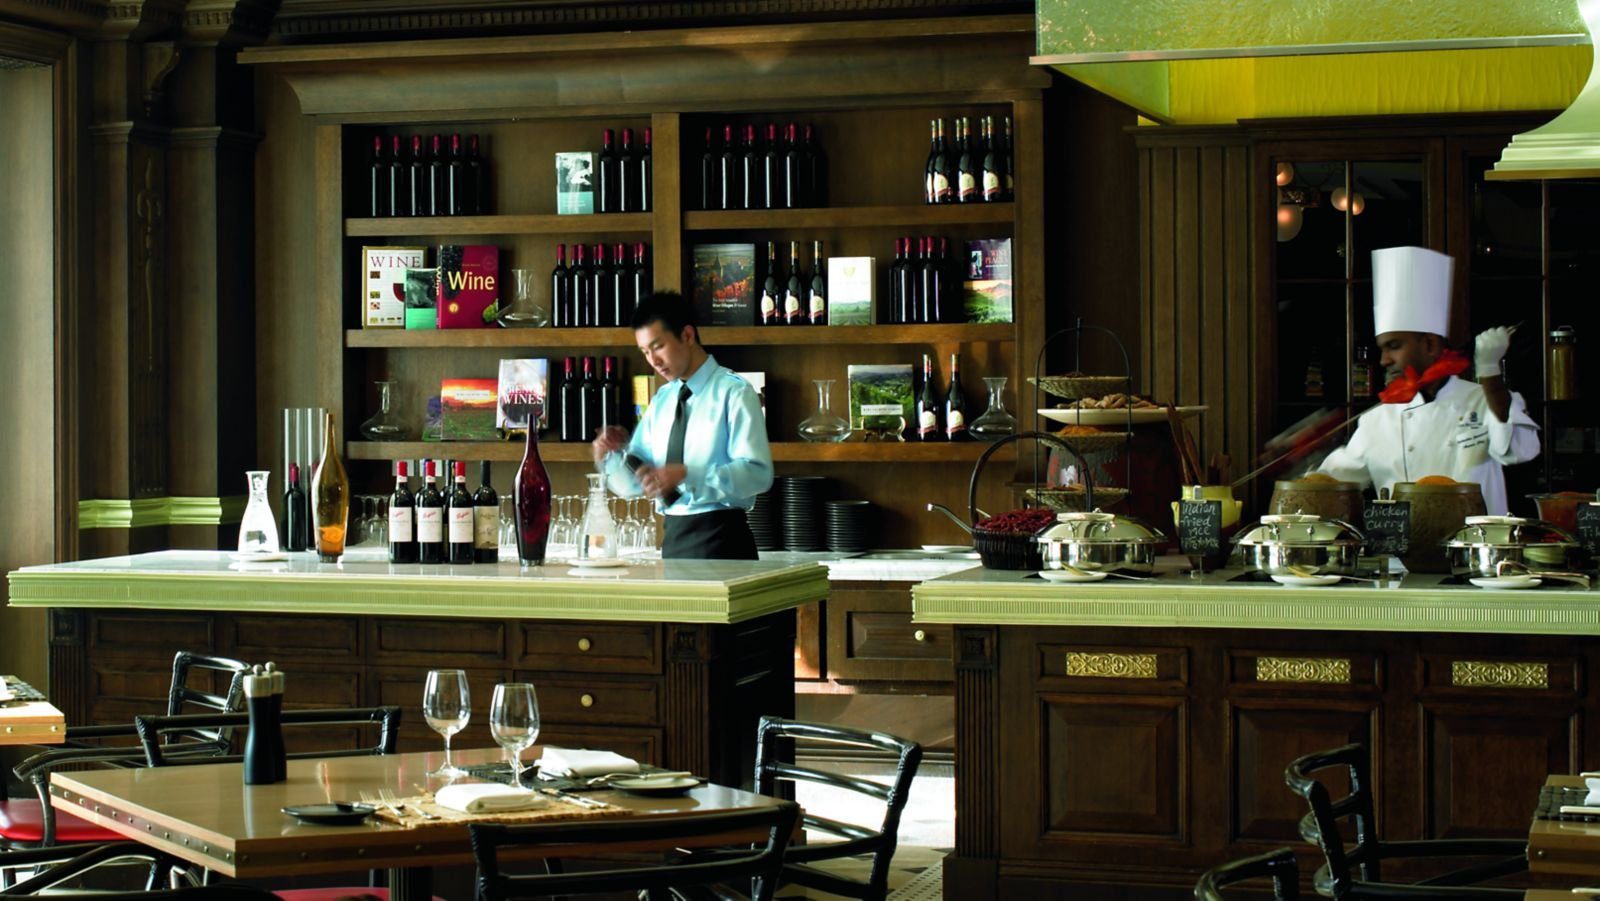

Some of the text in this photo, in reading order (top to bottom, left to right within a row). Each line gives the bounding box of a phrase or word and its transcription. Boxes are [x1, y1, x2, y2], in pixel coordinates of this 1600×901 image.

[370, 256, 421, 268] WINE
[447, 271, 495, 290] Wine
[502, 394, 545, 405] WINES
[1180, 516, 1211, 527] fried
